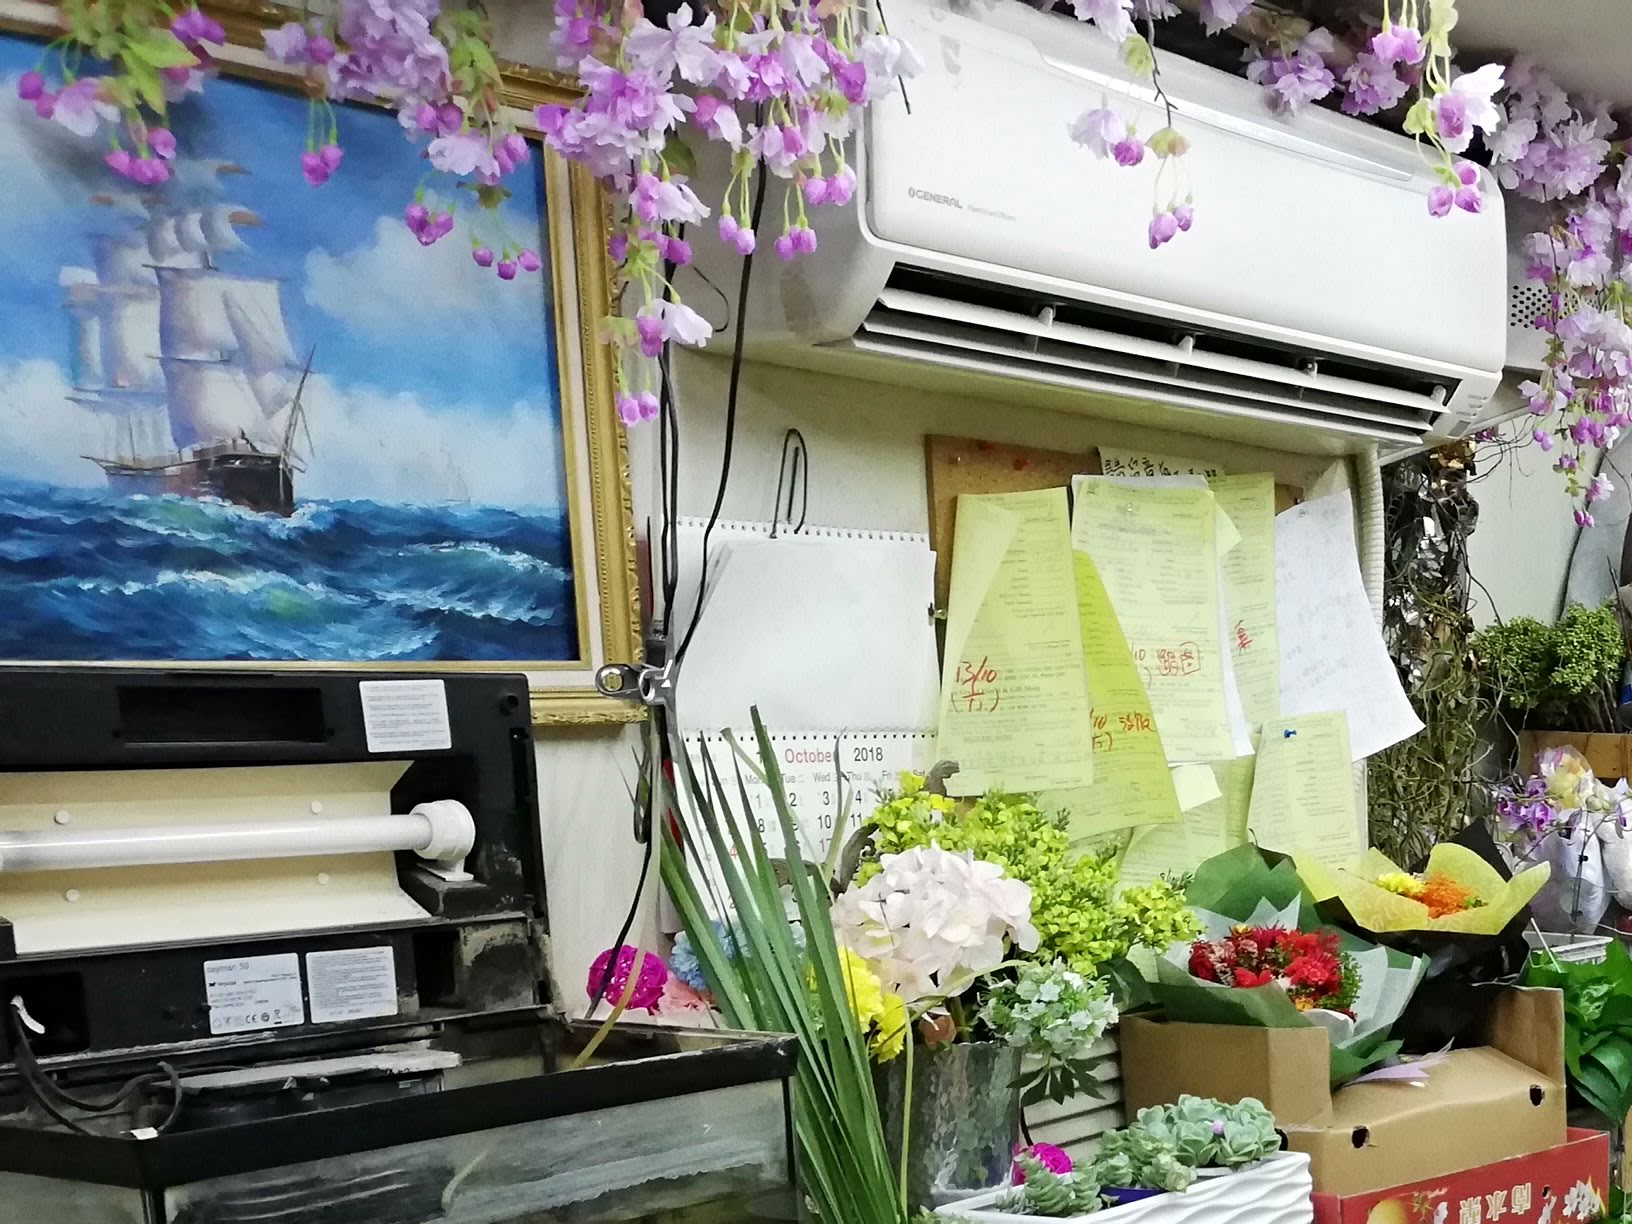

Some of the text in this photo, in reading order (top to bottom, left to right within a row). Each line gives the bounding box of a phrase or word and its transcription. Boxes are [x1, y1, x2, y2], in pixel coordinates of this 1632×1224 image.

[956, 656, 998, 685] 13/10
[785, 746, 884, 764] Octobe 2018
[789, 792, 797, 807] 2
[822, 790, 830, 806] 3
[855, 790, 862, 804] 4
[818, 813, 832, 829] 10
